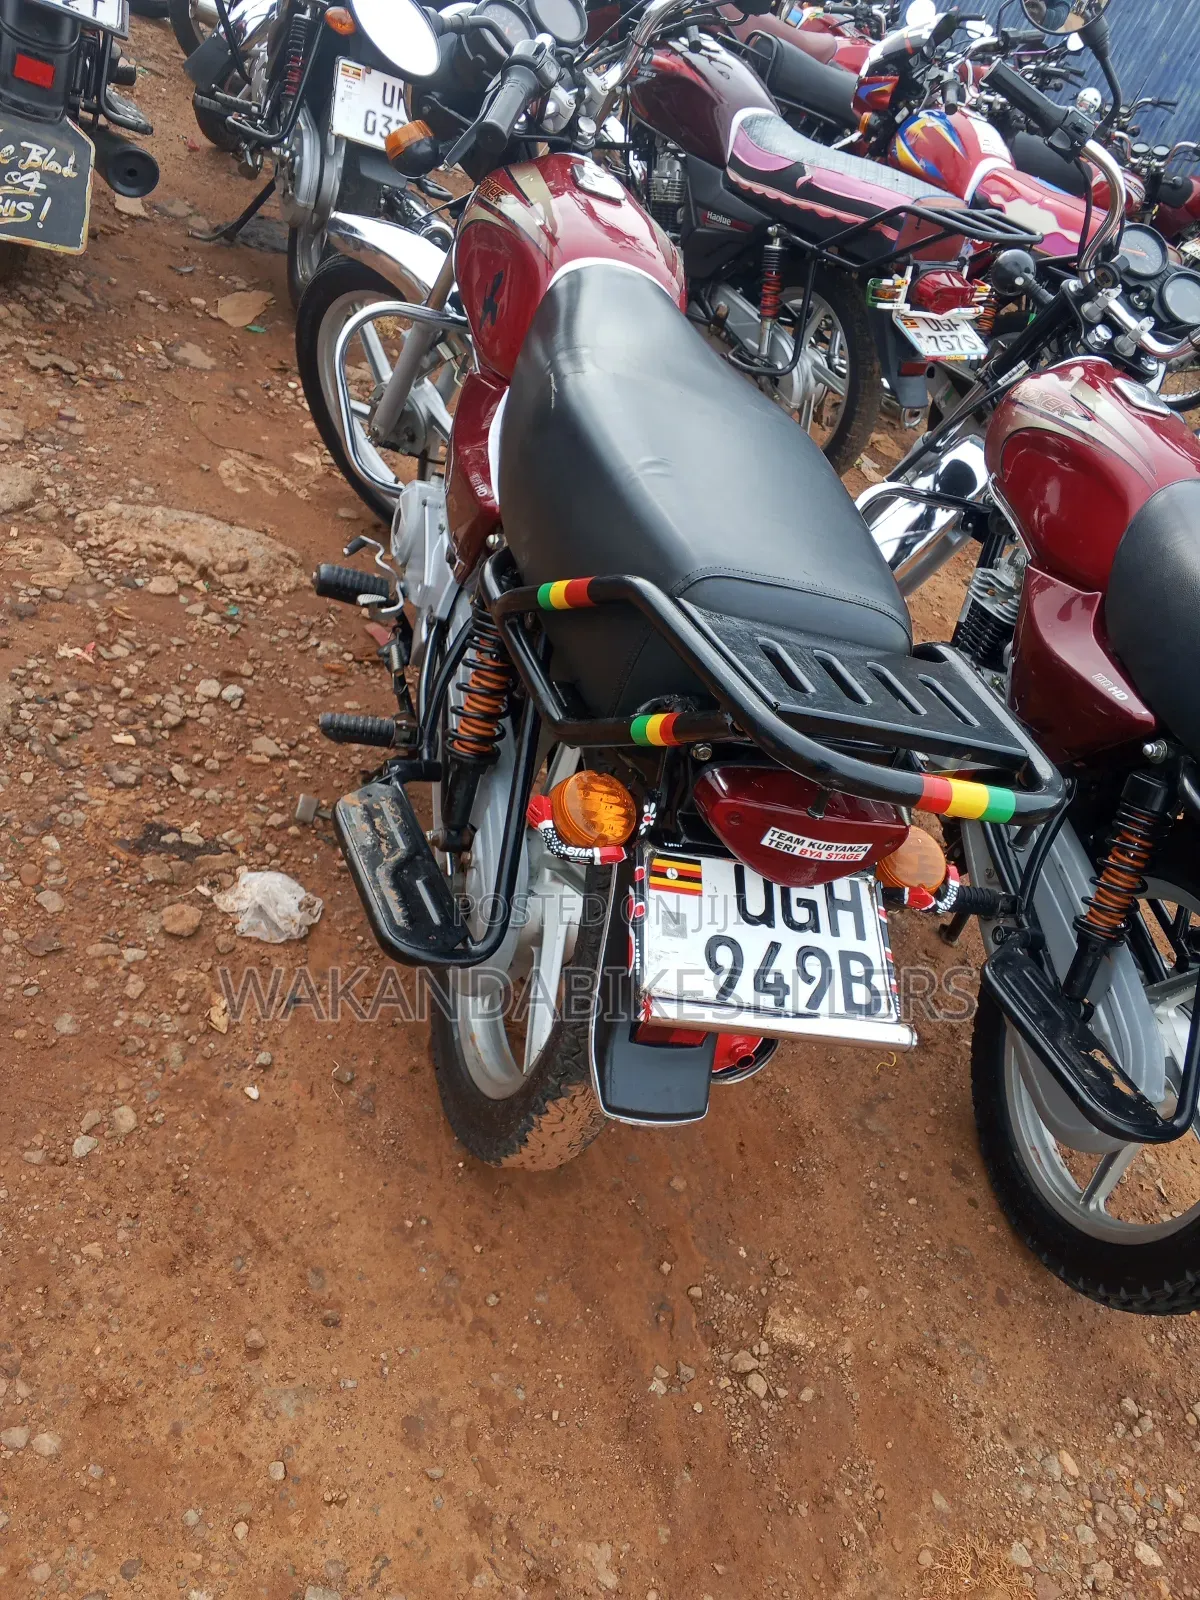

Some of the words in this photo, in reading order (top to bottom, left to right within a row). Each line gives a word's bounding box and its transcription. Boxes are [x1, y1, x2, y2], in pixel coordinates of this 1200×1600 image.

[706, 210, 731, 226] Haojue
[928, 334, 978, 351] 757S
[768, 838, 797, 853] TERI
[798, 847, 823, 859] BYA
[825, 852, 862, 860] STAGE
[770, 829, 806, 846] TEAM
[807, 840, 869, 853] KUBYANZA
[733, 864, 866, 941] UGH
[704, 934, 882, 1016] 949B
